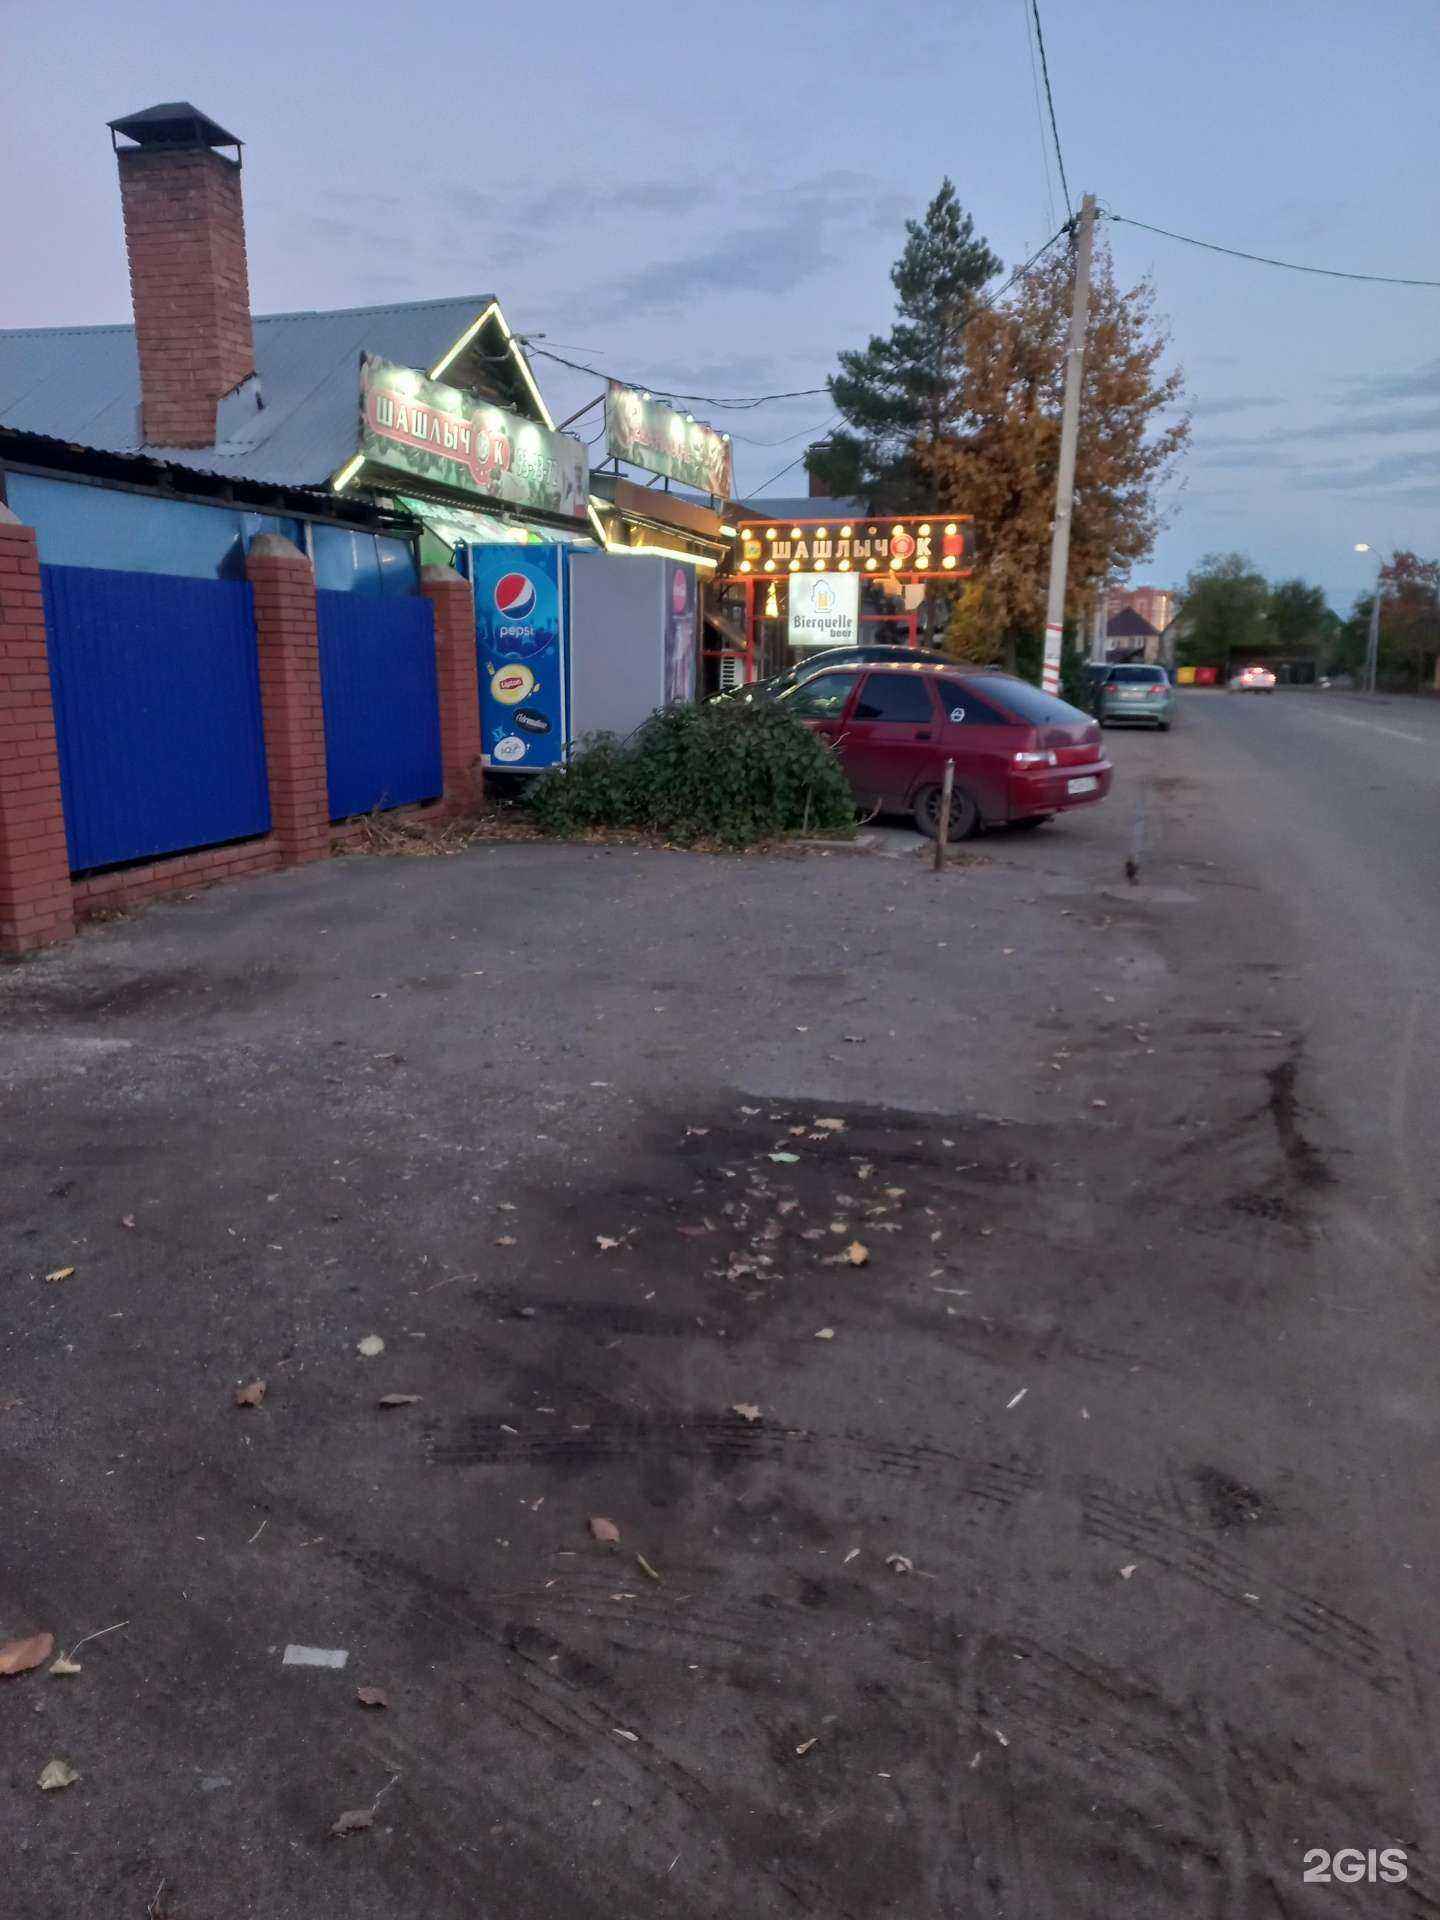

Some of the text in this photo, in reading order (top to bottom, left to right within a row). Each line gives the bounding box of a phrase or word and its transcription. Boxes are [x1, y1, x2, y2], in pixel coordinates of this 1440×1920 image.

[376, 396, 504, 466] ШАШЛЫЧОК
[771, 533, 932, 560] ШАШЛЫЧОК
[499, 624, 535, 639] pepsi
[793, 614, 853, 631] Bierquelle
